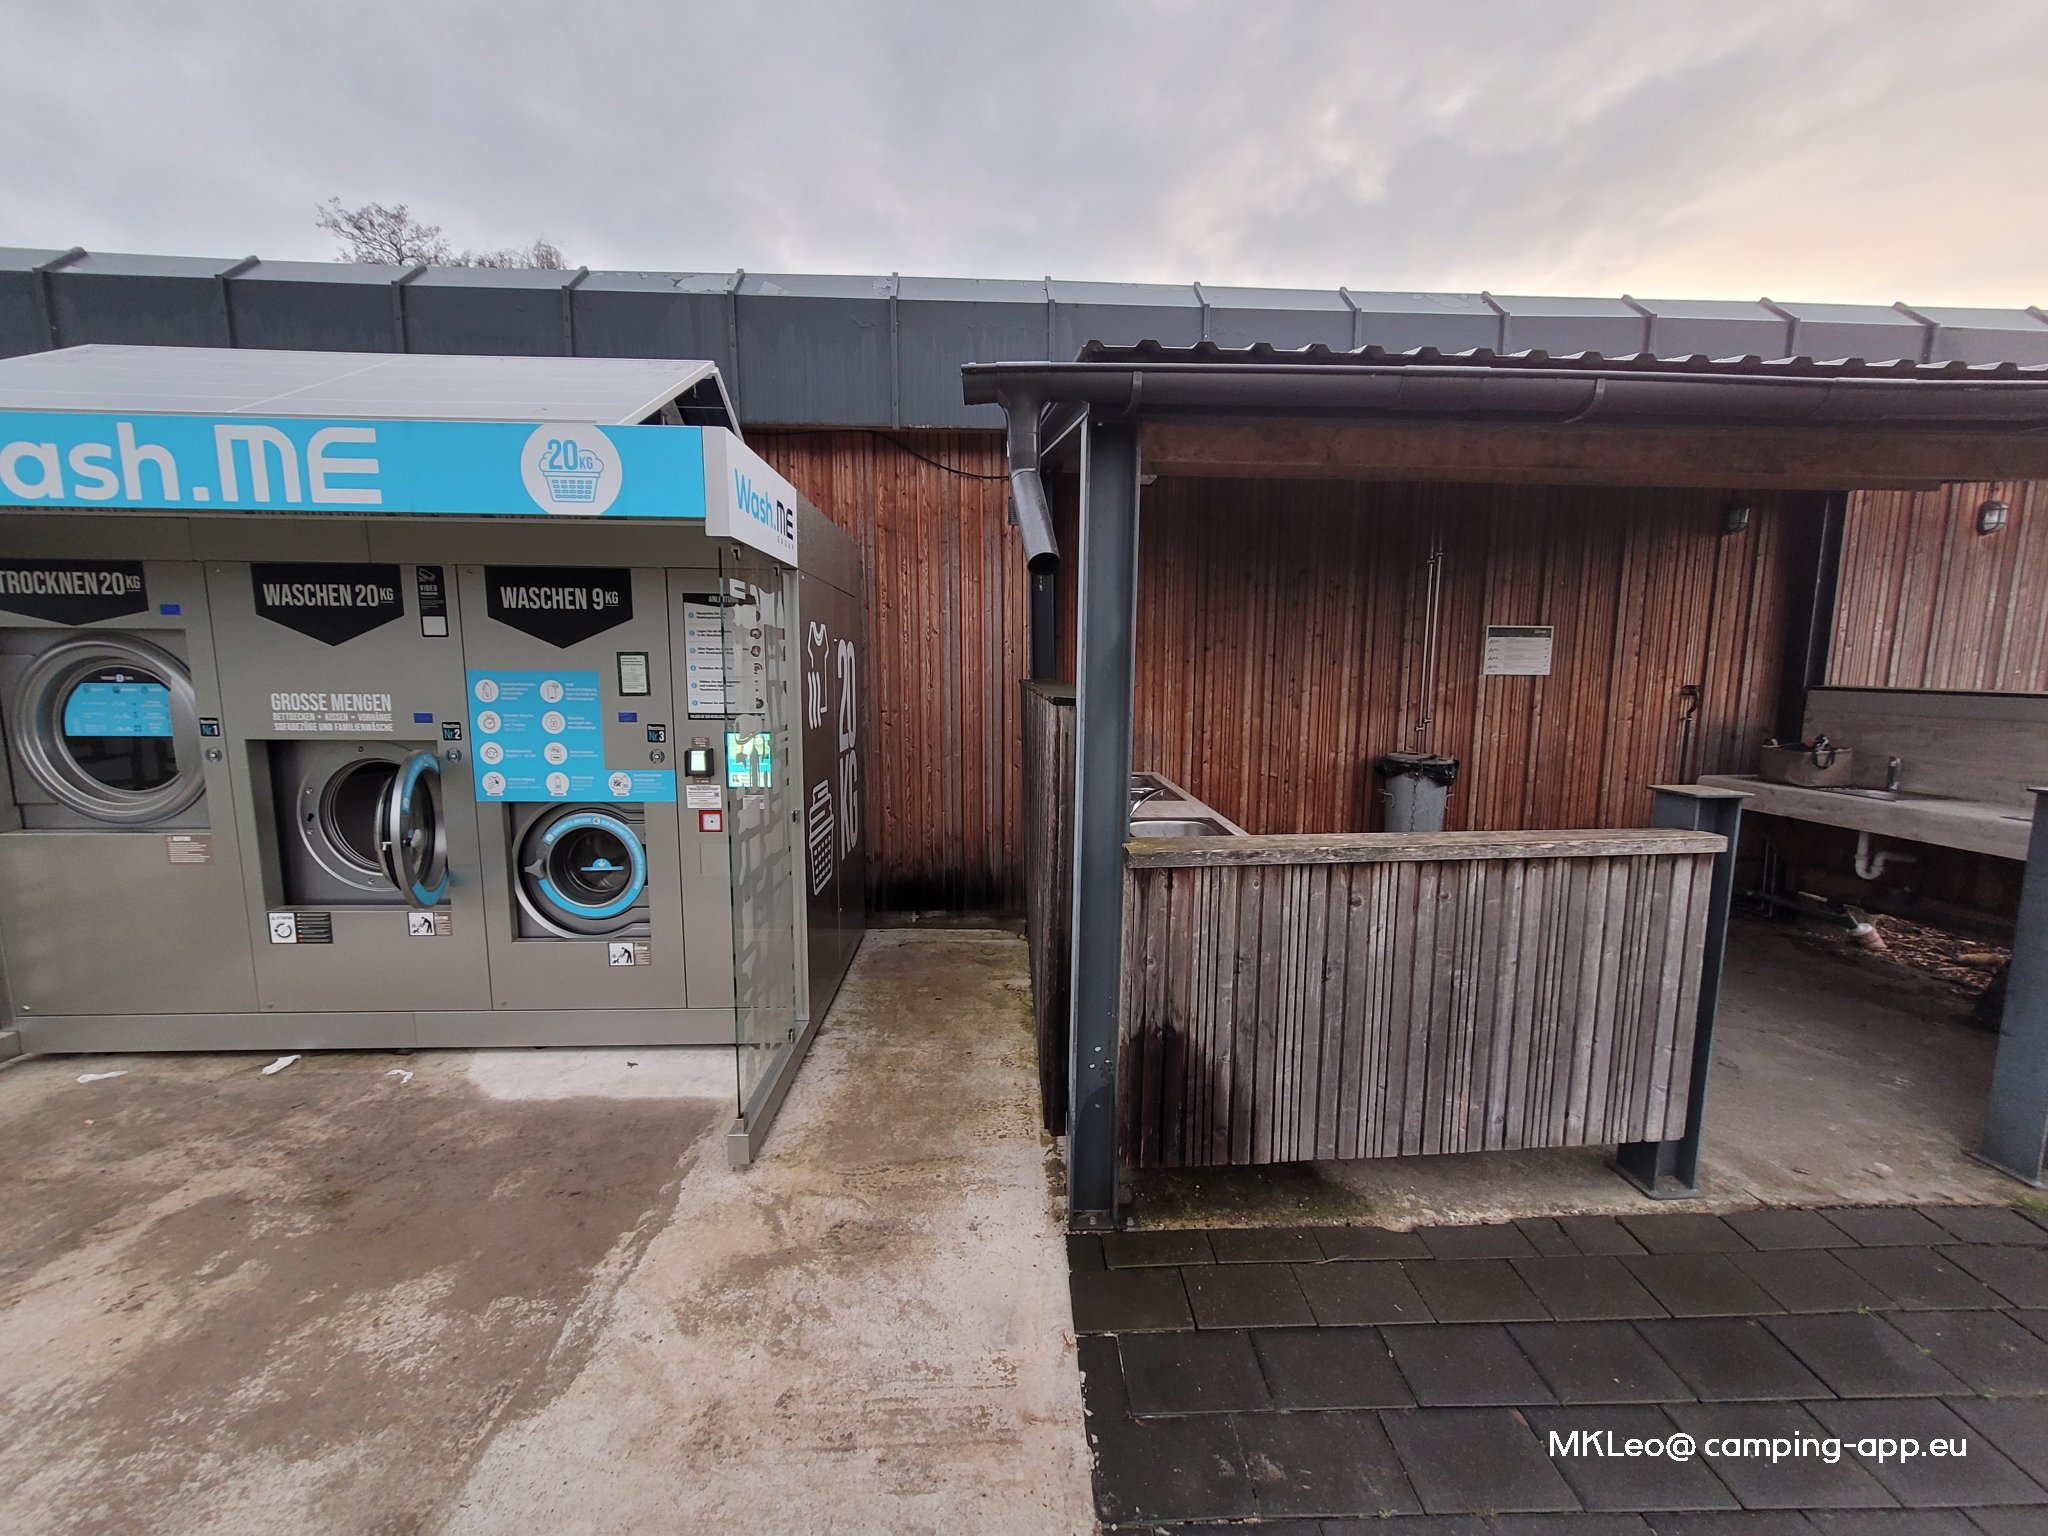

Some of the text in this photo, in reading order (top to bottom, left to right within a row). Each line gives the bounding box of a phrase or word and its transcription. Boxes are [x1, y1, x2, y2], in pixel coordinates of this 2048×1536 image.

[734, 467, 795, 541] Wash.ME
[0, 570, 99, 595] TROCKNEN
[262, 583, 353, 607] WASCHEN
[500, 586, 588, 610] WASCHEN
[270, 692, 392, 712] GROSSE MENGEN
